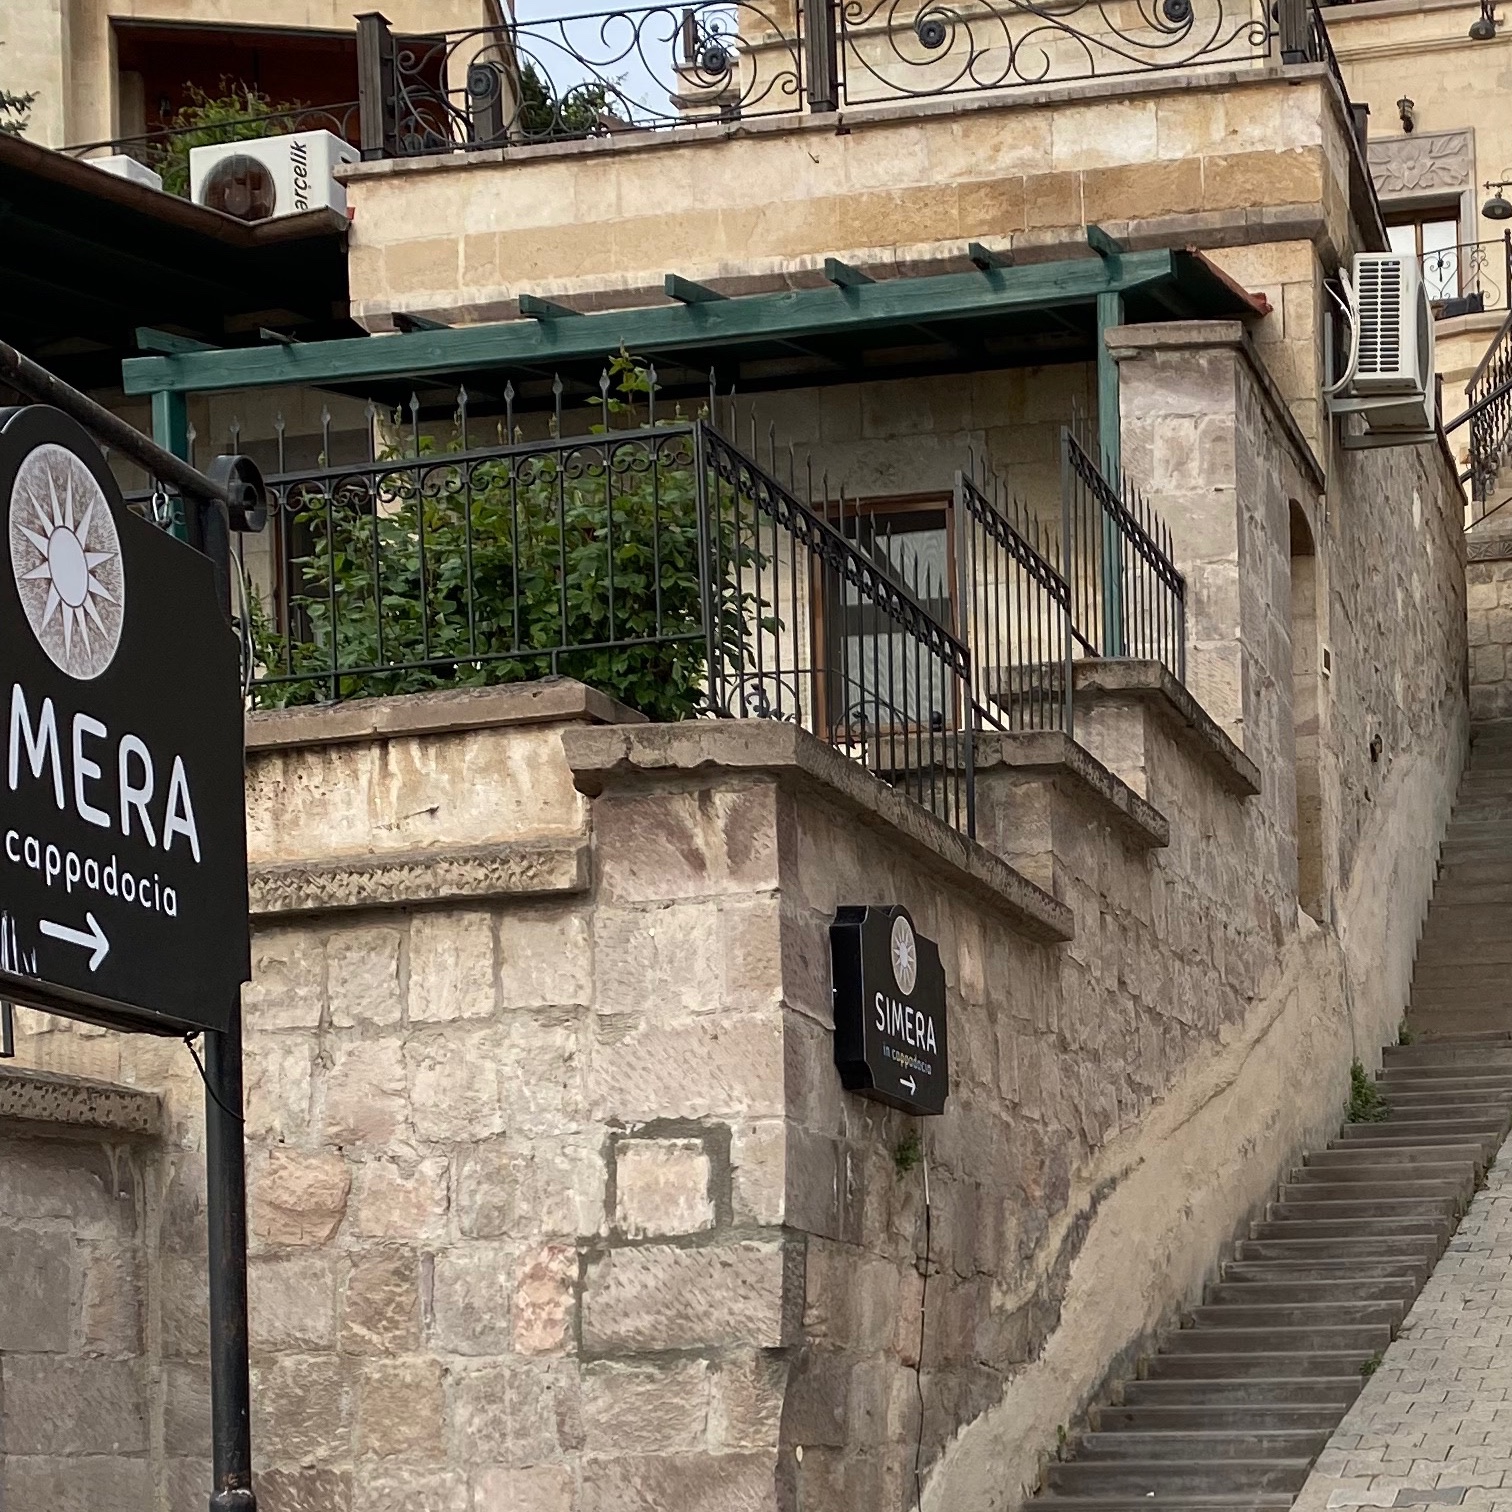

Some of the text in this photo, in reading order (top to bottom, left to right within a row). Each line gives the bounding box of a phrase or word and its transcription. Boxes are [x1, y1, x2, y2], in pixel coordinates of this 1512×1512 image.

[290, 141, 312, 211] arçelik
[8, 683, 200, 863] MERA
[5, 829, 178, 917] cappadocia
[874, 991, 937, 1056] SIMERA
[882, 1041, 932, 1076] in cappadocia
